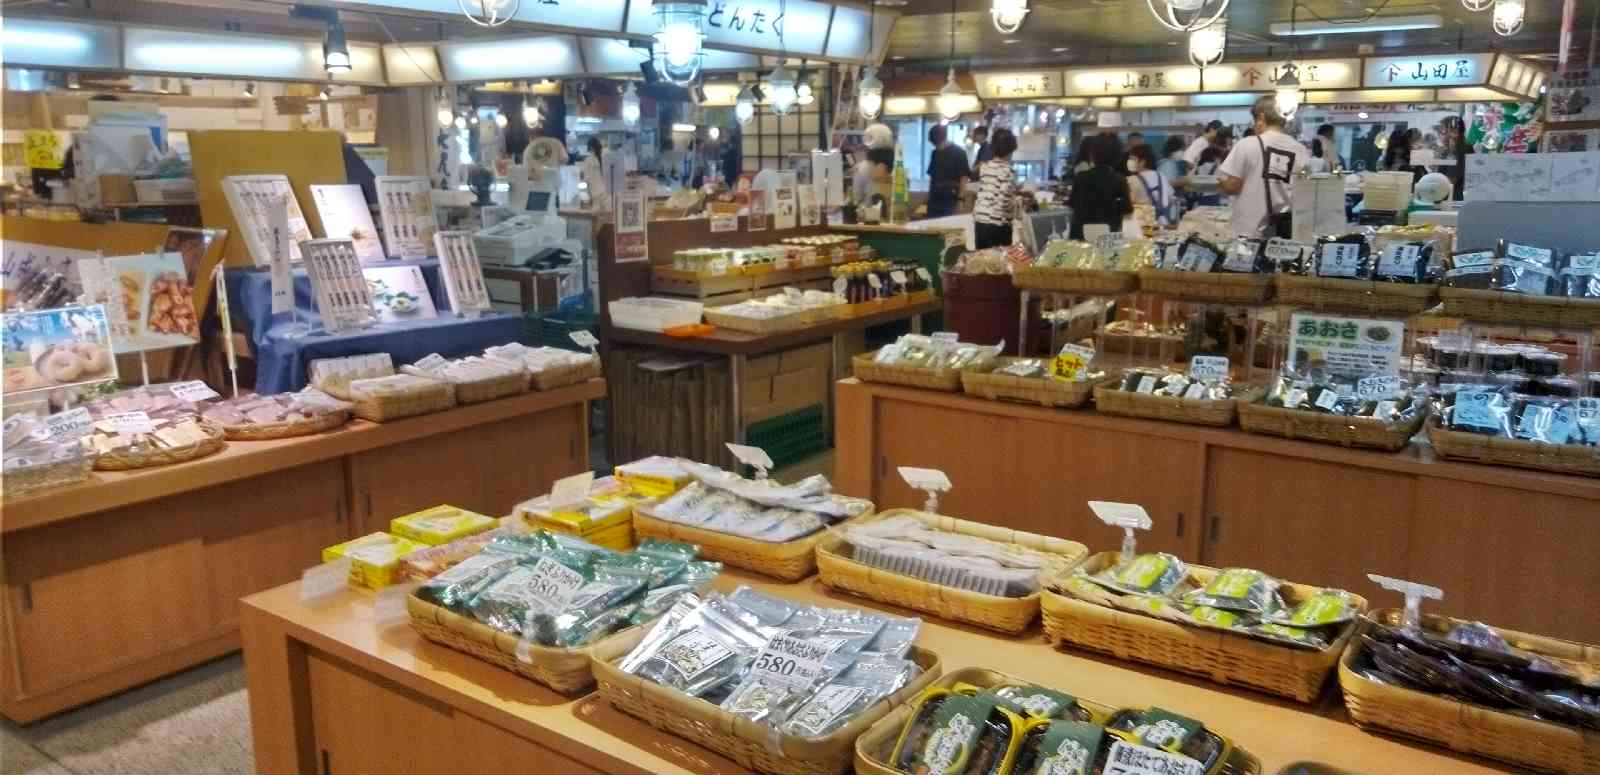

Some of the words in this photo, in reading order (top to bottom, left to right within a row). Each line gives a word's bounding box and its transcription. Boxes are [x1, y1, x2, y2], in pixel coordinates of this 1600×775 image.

[708, 2, 784, 37] どんたく
[1412, 59, 1471, 80] 山田屋
[1298, 319, 1359, 338] あおさ
[50, 421, 79, 437] 200
[528, 574, 559, 598] 580
[756, 652, 796, 675] 580
